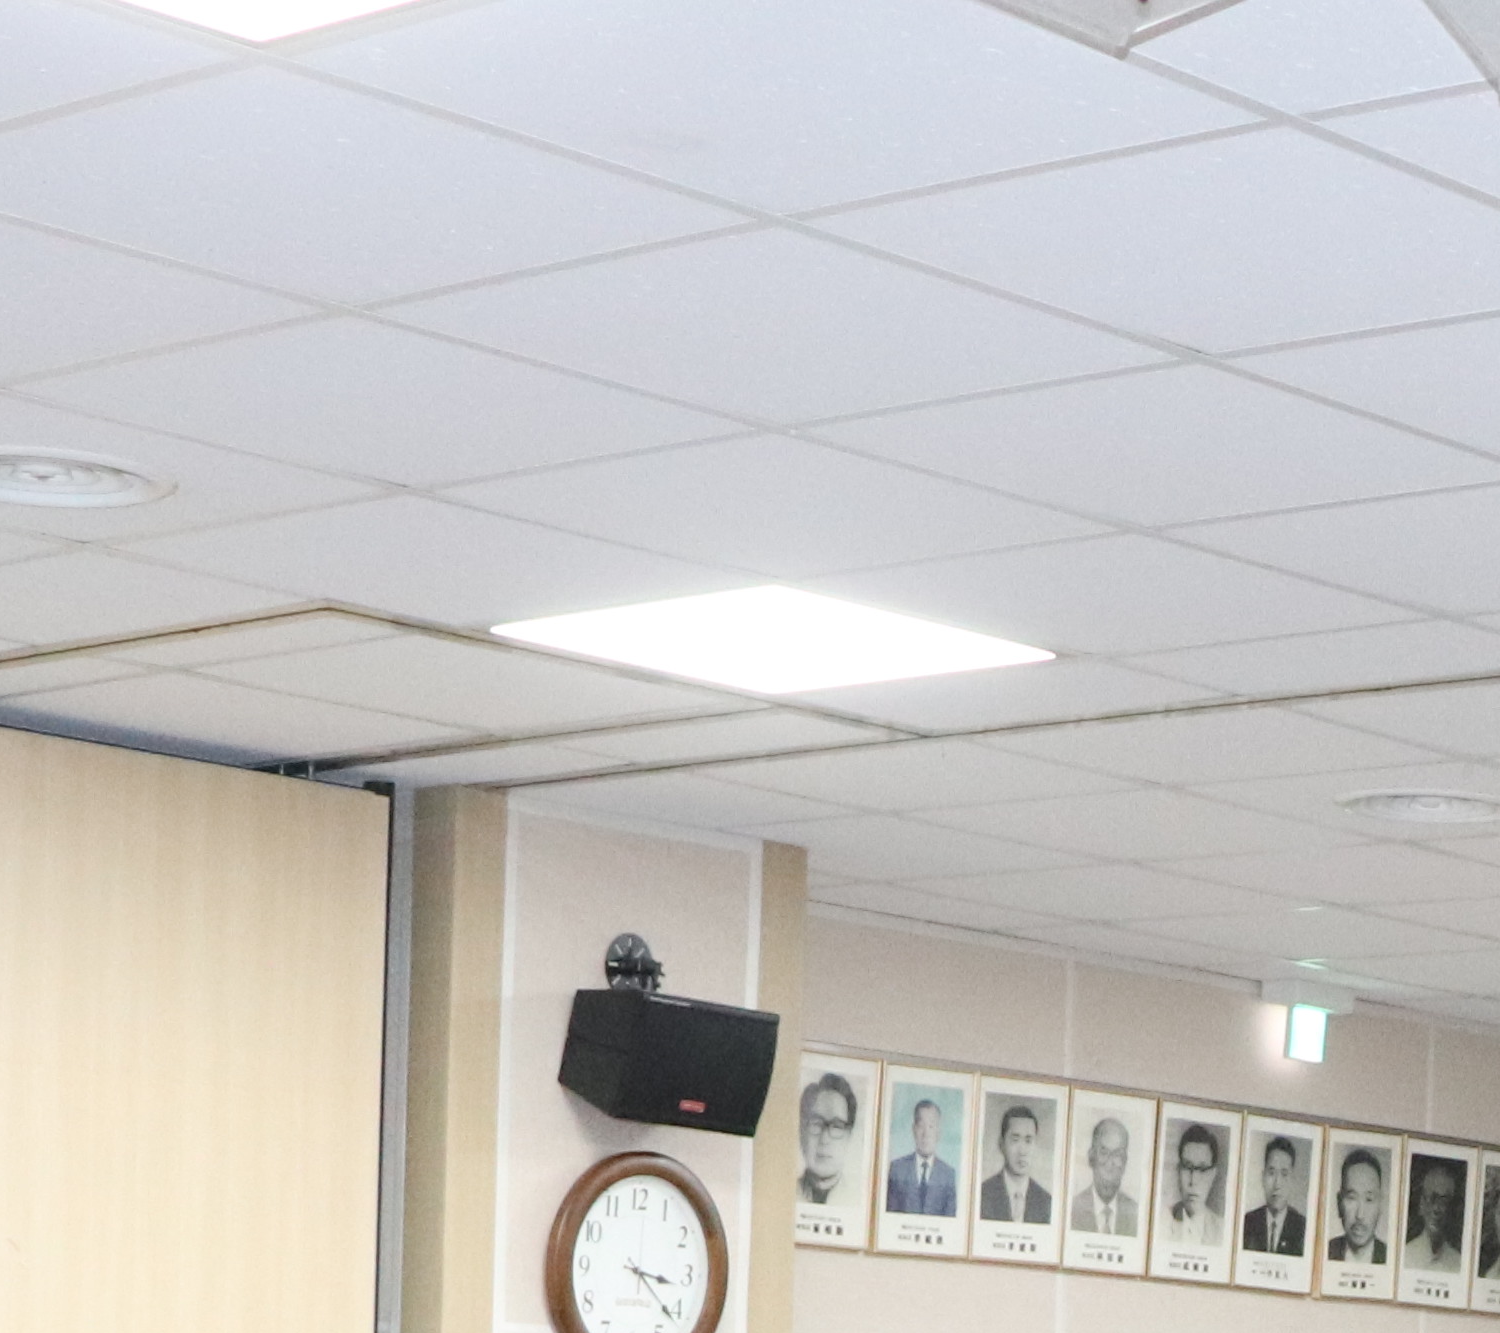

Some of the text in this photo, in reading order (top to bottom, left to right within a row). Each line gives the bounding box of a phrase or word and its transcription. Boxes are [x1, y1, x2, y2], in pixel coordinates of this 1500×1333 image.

[605, 1194, 620, 1218] 11
[631, 1187, 650, 1211] 12
[585, 1219, 603, 1244] 10
[676, 1226, 689, 1249] 2
[578, 1254, 591, 1276] 9
[680, 1264, 694, 1287] 3
[581, 1290, 595, 1313] 8
